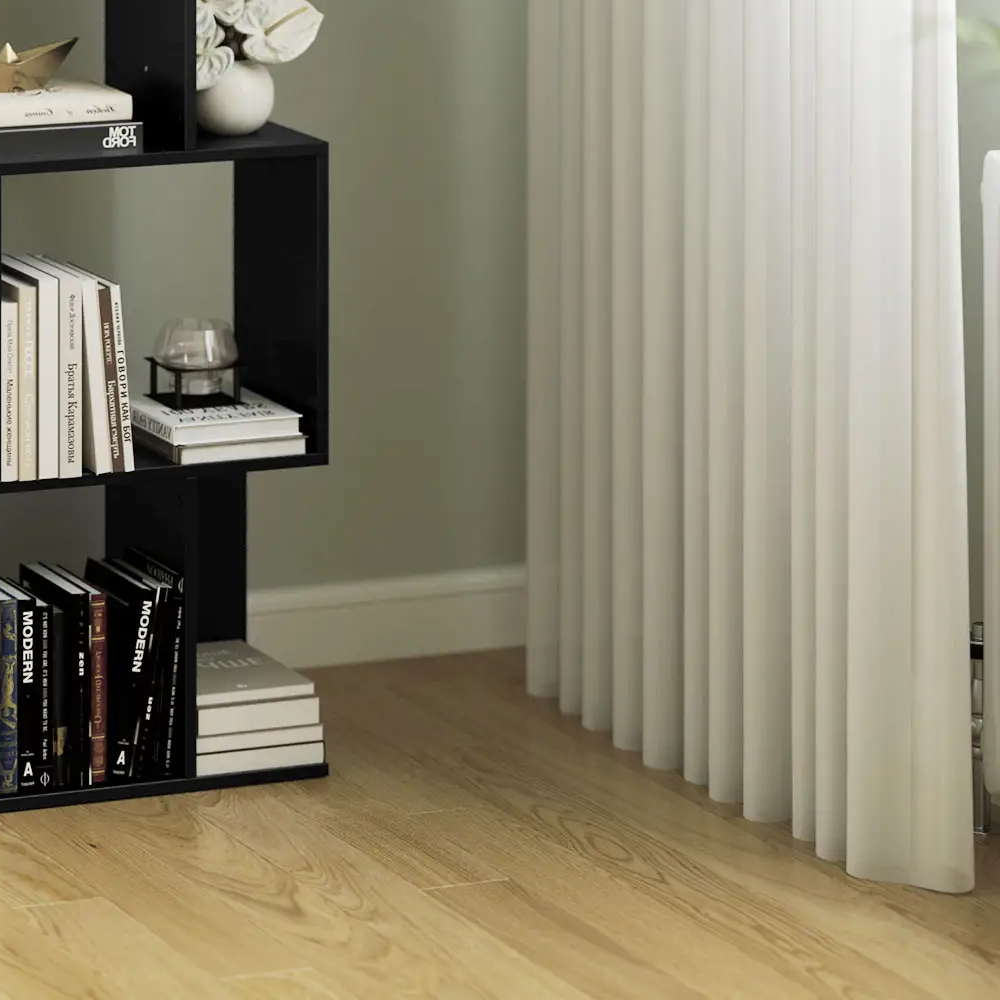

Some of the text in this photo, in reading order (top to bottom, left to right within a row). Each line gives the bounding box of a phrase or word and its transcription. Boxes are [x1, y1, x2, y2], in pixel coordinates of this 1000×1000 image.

[65, 363, 77, 463] Братья Карамазовы
[117, 350, 131, 443] ГОВОРИ КАК БОГ
[22, 611, 33, 684] MODERN
[132, 600, 152, 673] MODERN
[145, 696, 153, 720] zen
[23, 761, 33, 776] A
[116, 750, 126, 765] A
